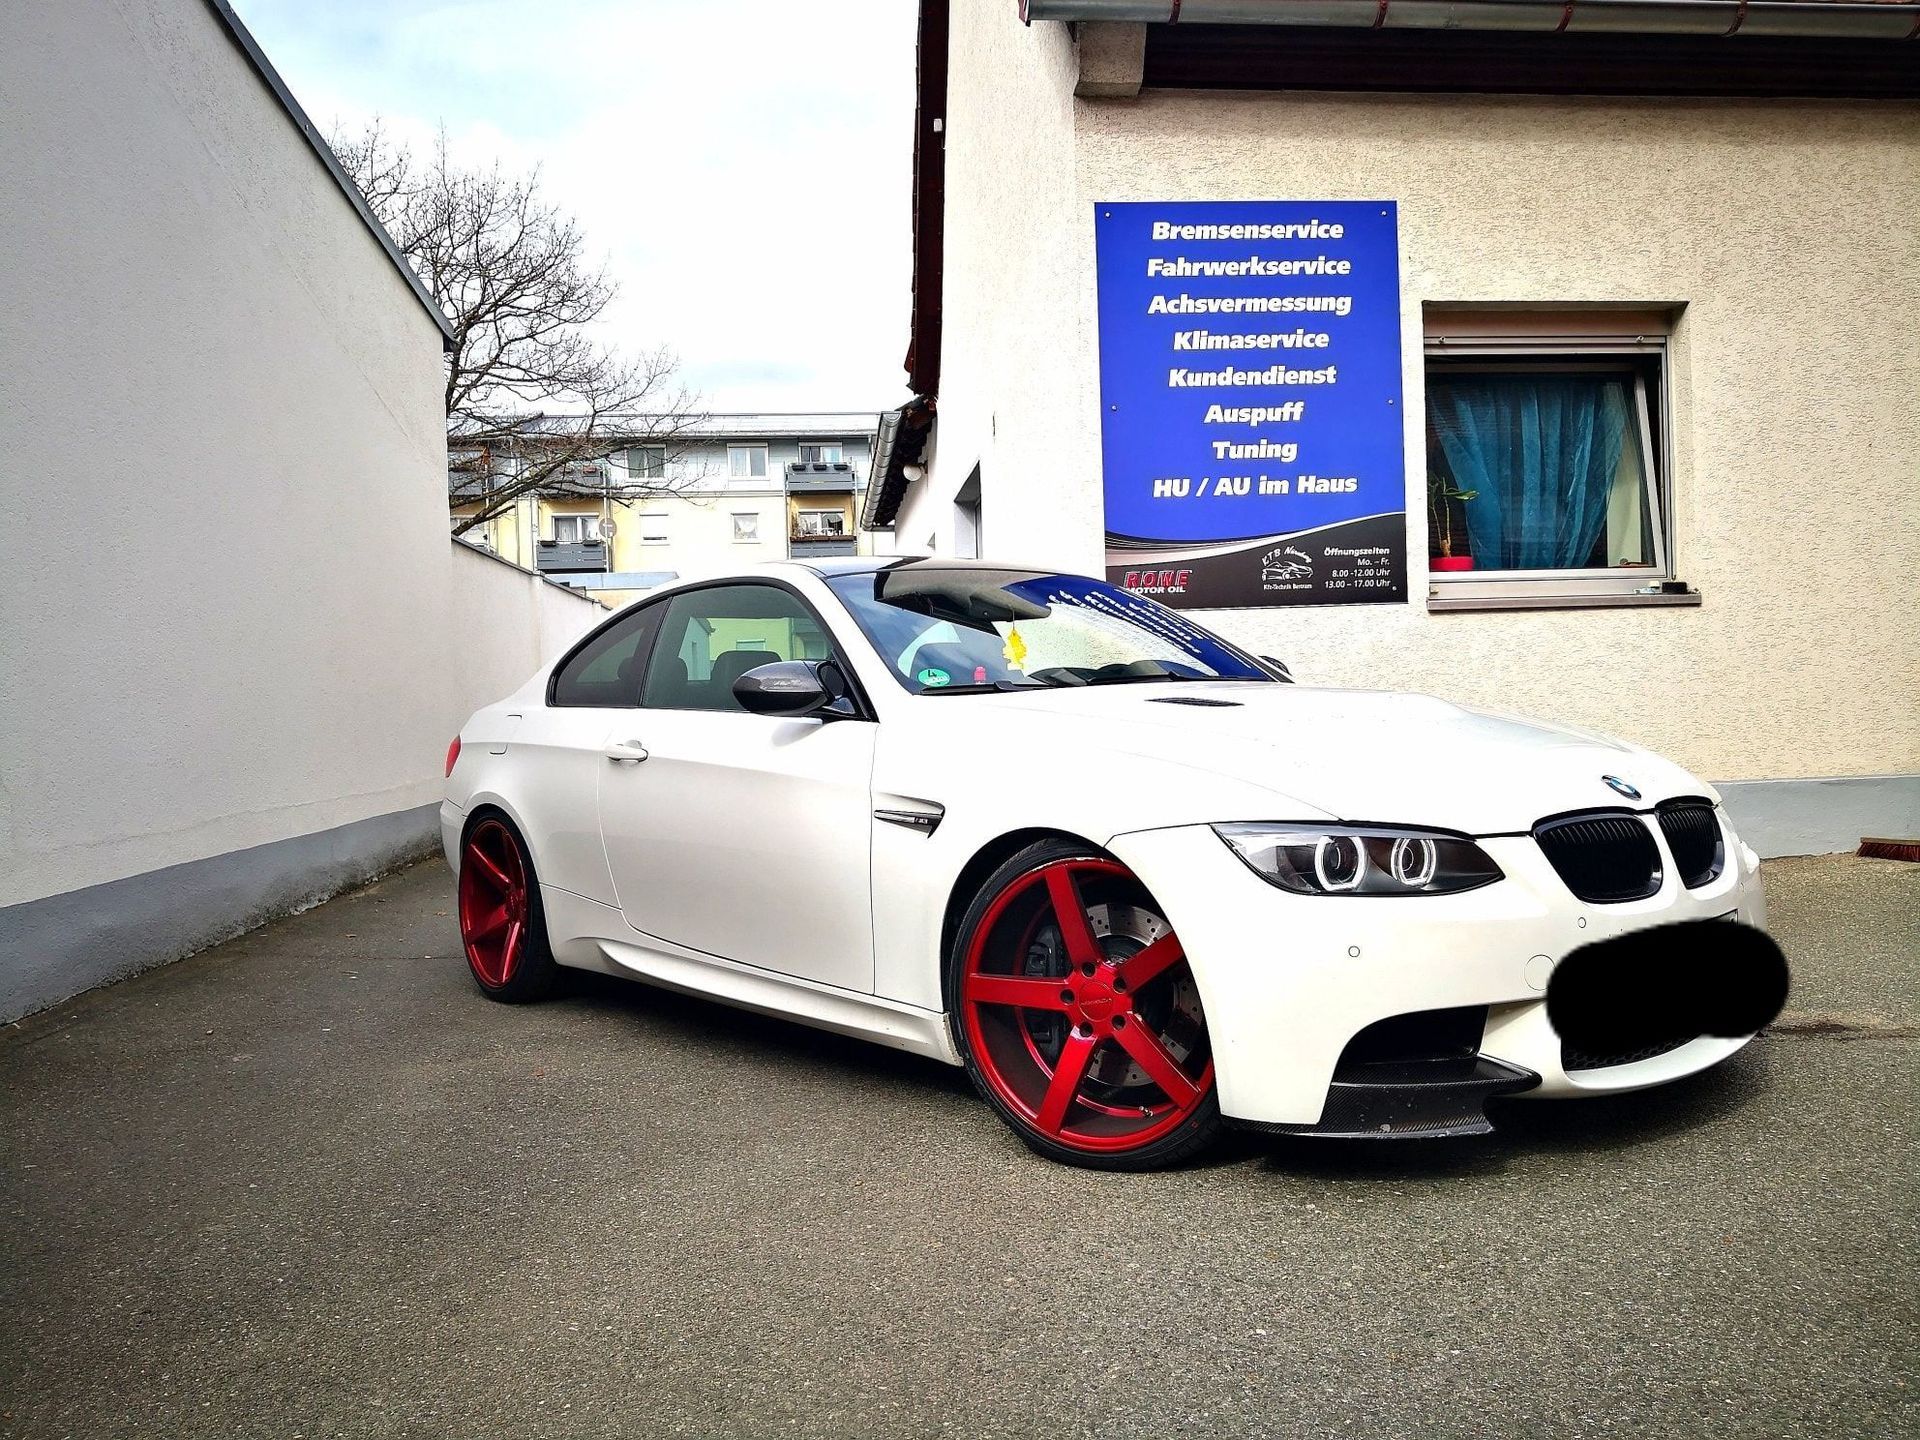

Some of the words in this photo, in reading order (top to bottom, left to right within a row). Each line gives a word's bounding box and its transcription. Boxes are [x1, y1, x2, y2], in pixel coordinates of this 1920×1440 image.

[1152, 219, 1344, 241] Bremsenservice
[1147, 255, 1352, 277] Fahrwerkservice
[1147, 293, 1353, 317] Achsvermessung
[1173, 328, 1330, 351] Klimaservice
[1168, 365, 1337, 388] Kundendienst
[1203, 400, 1305, 427] Auspuff
[1212, 438, 1298, 463] Tuning
[1153, 478, 1190, 498] HU
[1196, 477, 1209, 497] /
[1213, 476, 1251, 497] AU
[1258, 474, 1290, 495] im
[1297, 474, 1358, 494] Haus
[1323, 546, 1390, 557] Öffnungszeiten
[1357, 557, 1373, 566] Mo.
[1380, 557, 1390, 566] Fr.
[1325, 580, 1346, 589] 13.00
[1354, 579, 1375, 588] 17.00
[1376, 578, 1391, 588] Uhr
[1332, 569, 1349, 578] 8.00
[1375, 567, 1391, 577] Uhr
[1167, 585, 1186, 593] OIL
